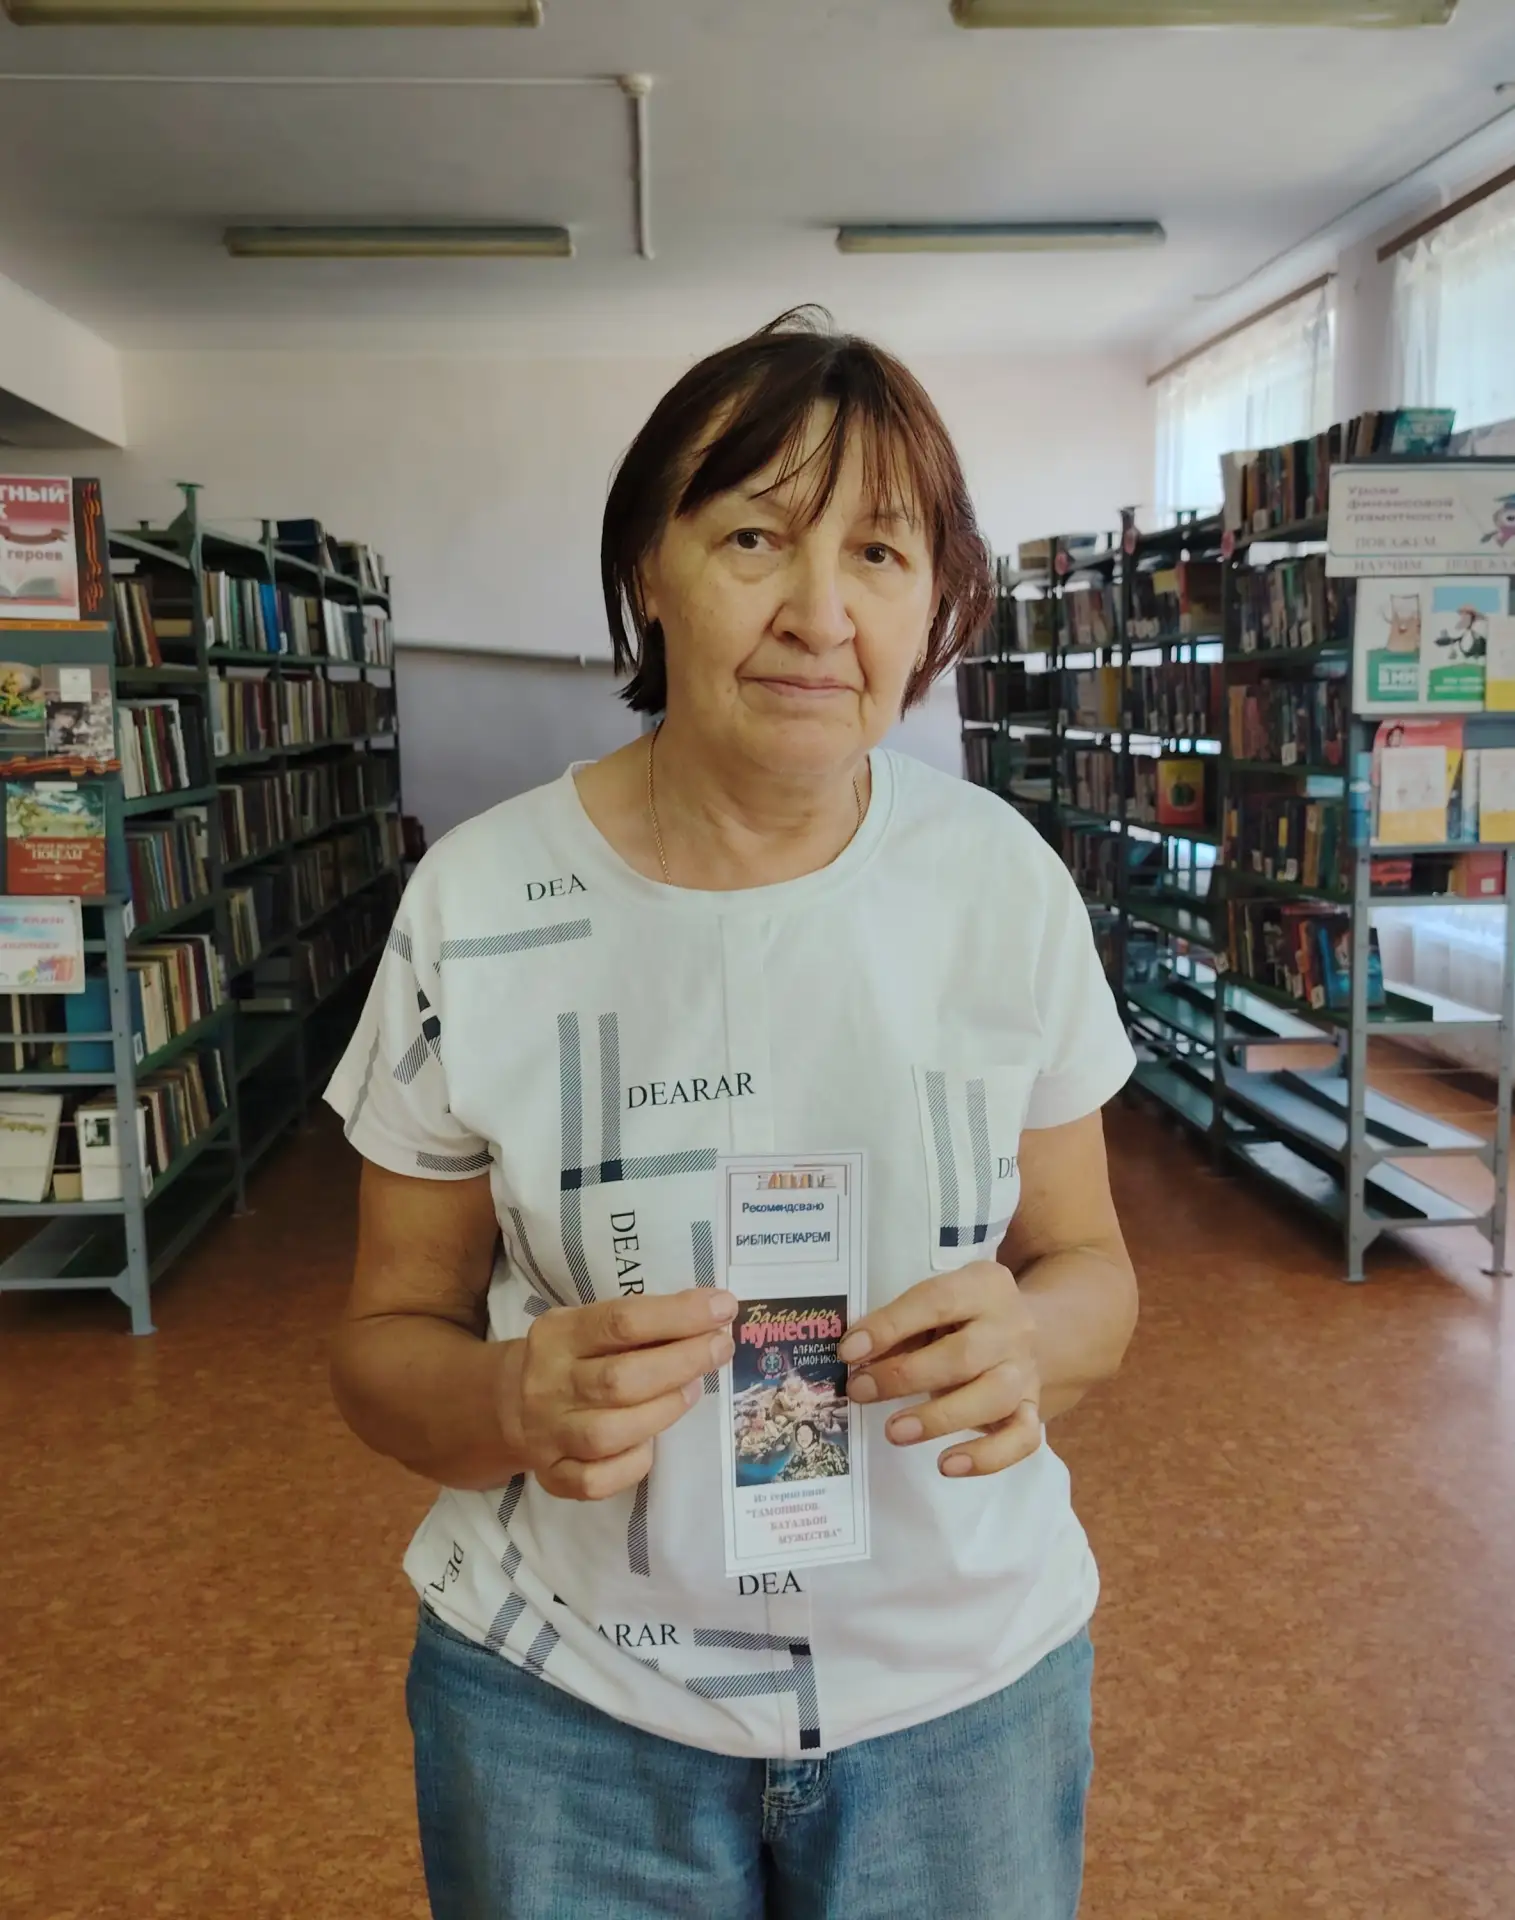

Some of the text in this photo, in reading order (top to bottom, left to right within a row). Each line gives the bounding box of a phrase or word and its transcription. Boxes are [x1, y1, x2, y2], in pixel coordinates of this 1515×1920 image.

[7, 550, 63, 563] героев
[525, 873, 588, 902] DEA
[627, 1072, 757, 1110] DEARAR
[738, 1570, 805, 1596] DEA
